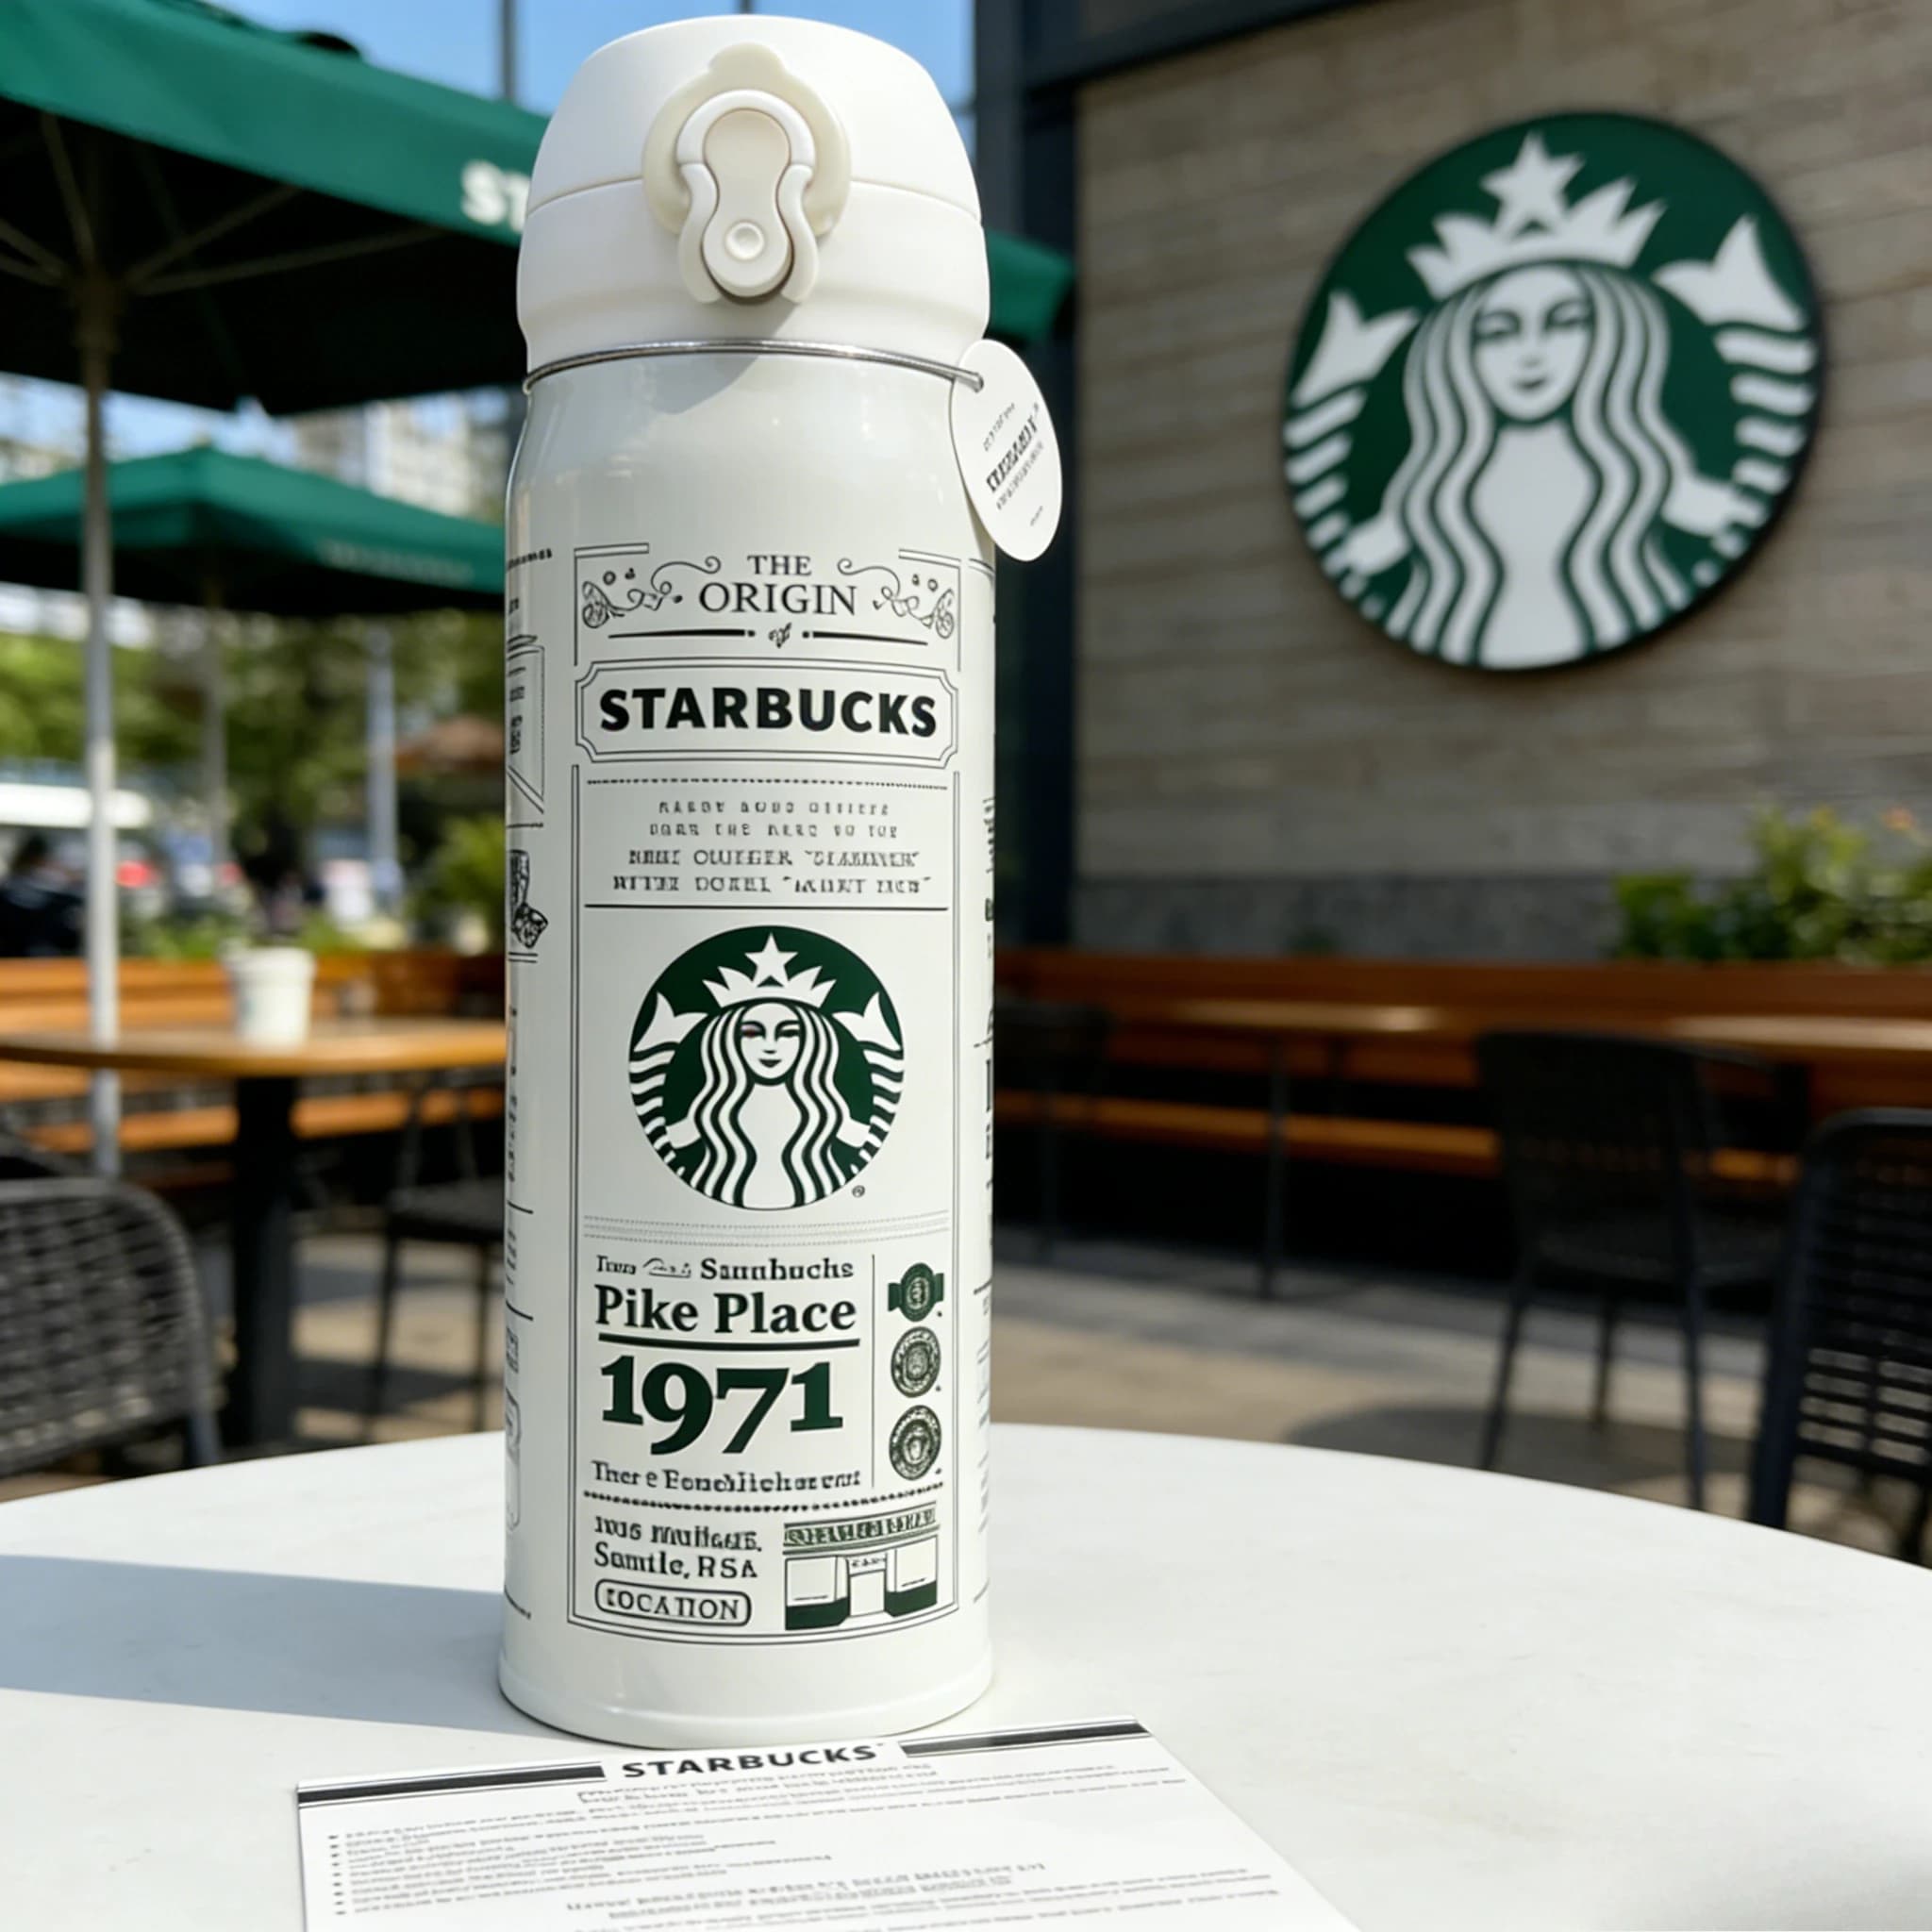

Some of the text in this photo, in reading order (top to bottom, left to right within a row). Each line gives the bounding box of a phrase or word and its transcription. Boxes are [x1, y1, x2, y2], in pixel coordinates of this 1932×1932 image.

[746, 554, 811, 576] THE
[698, 581, 858, 615] ORIGIN
[599, 687, 937, 738] STARBUCKS
[593, 1284, 857, 1334] Pike Place
[601, 1355, 843, 1456] 1971
[622, 1744, 876, 1778] STARBUCKS
